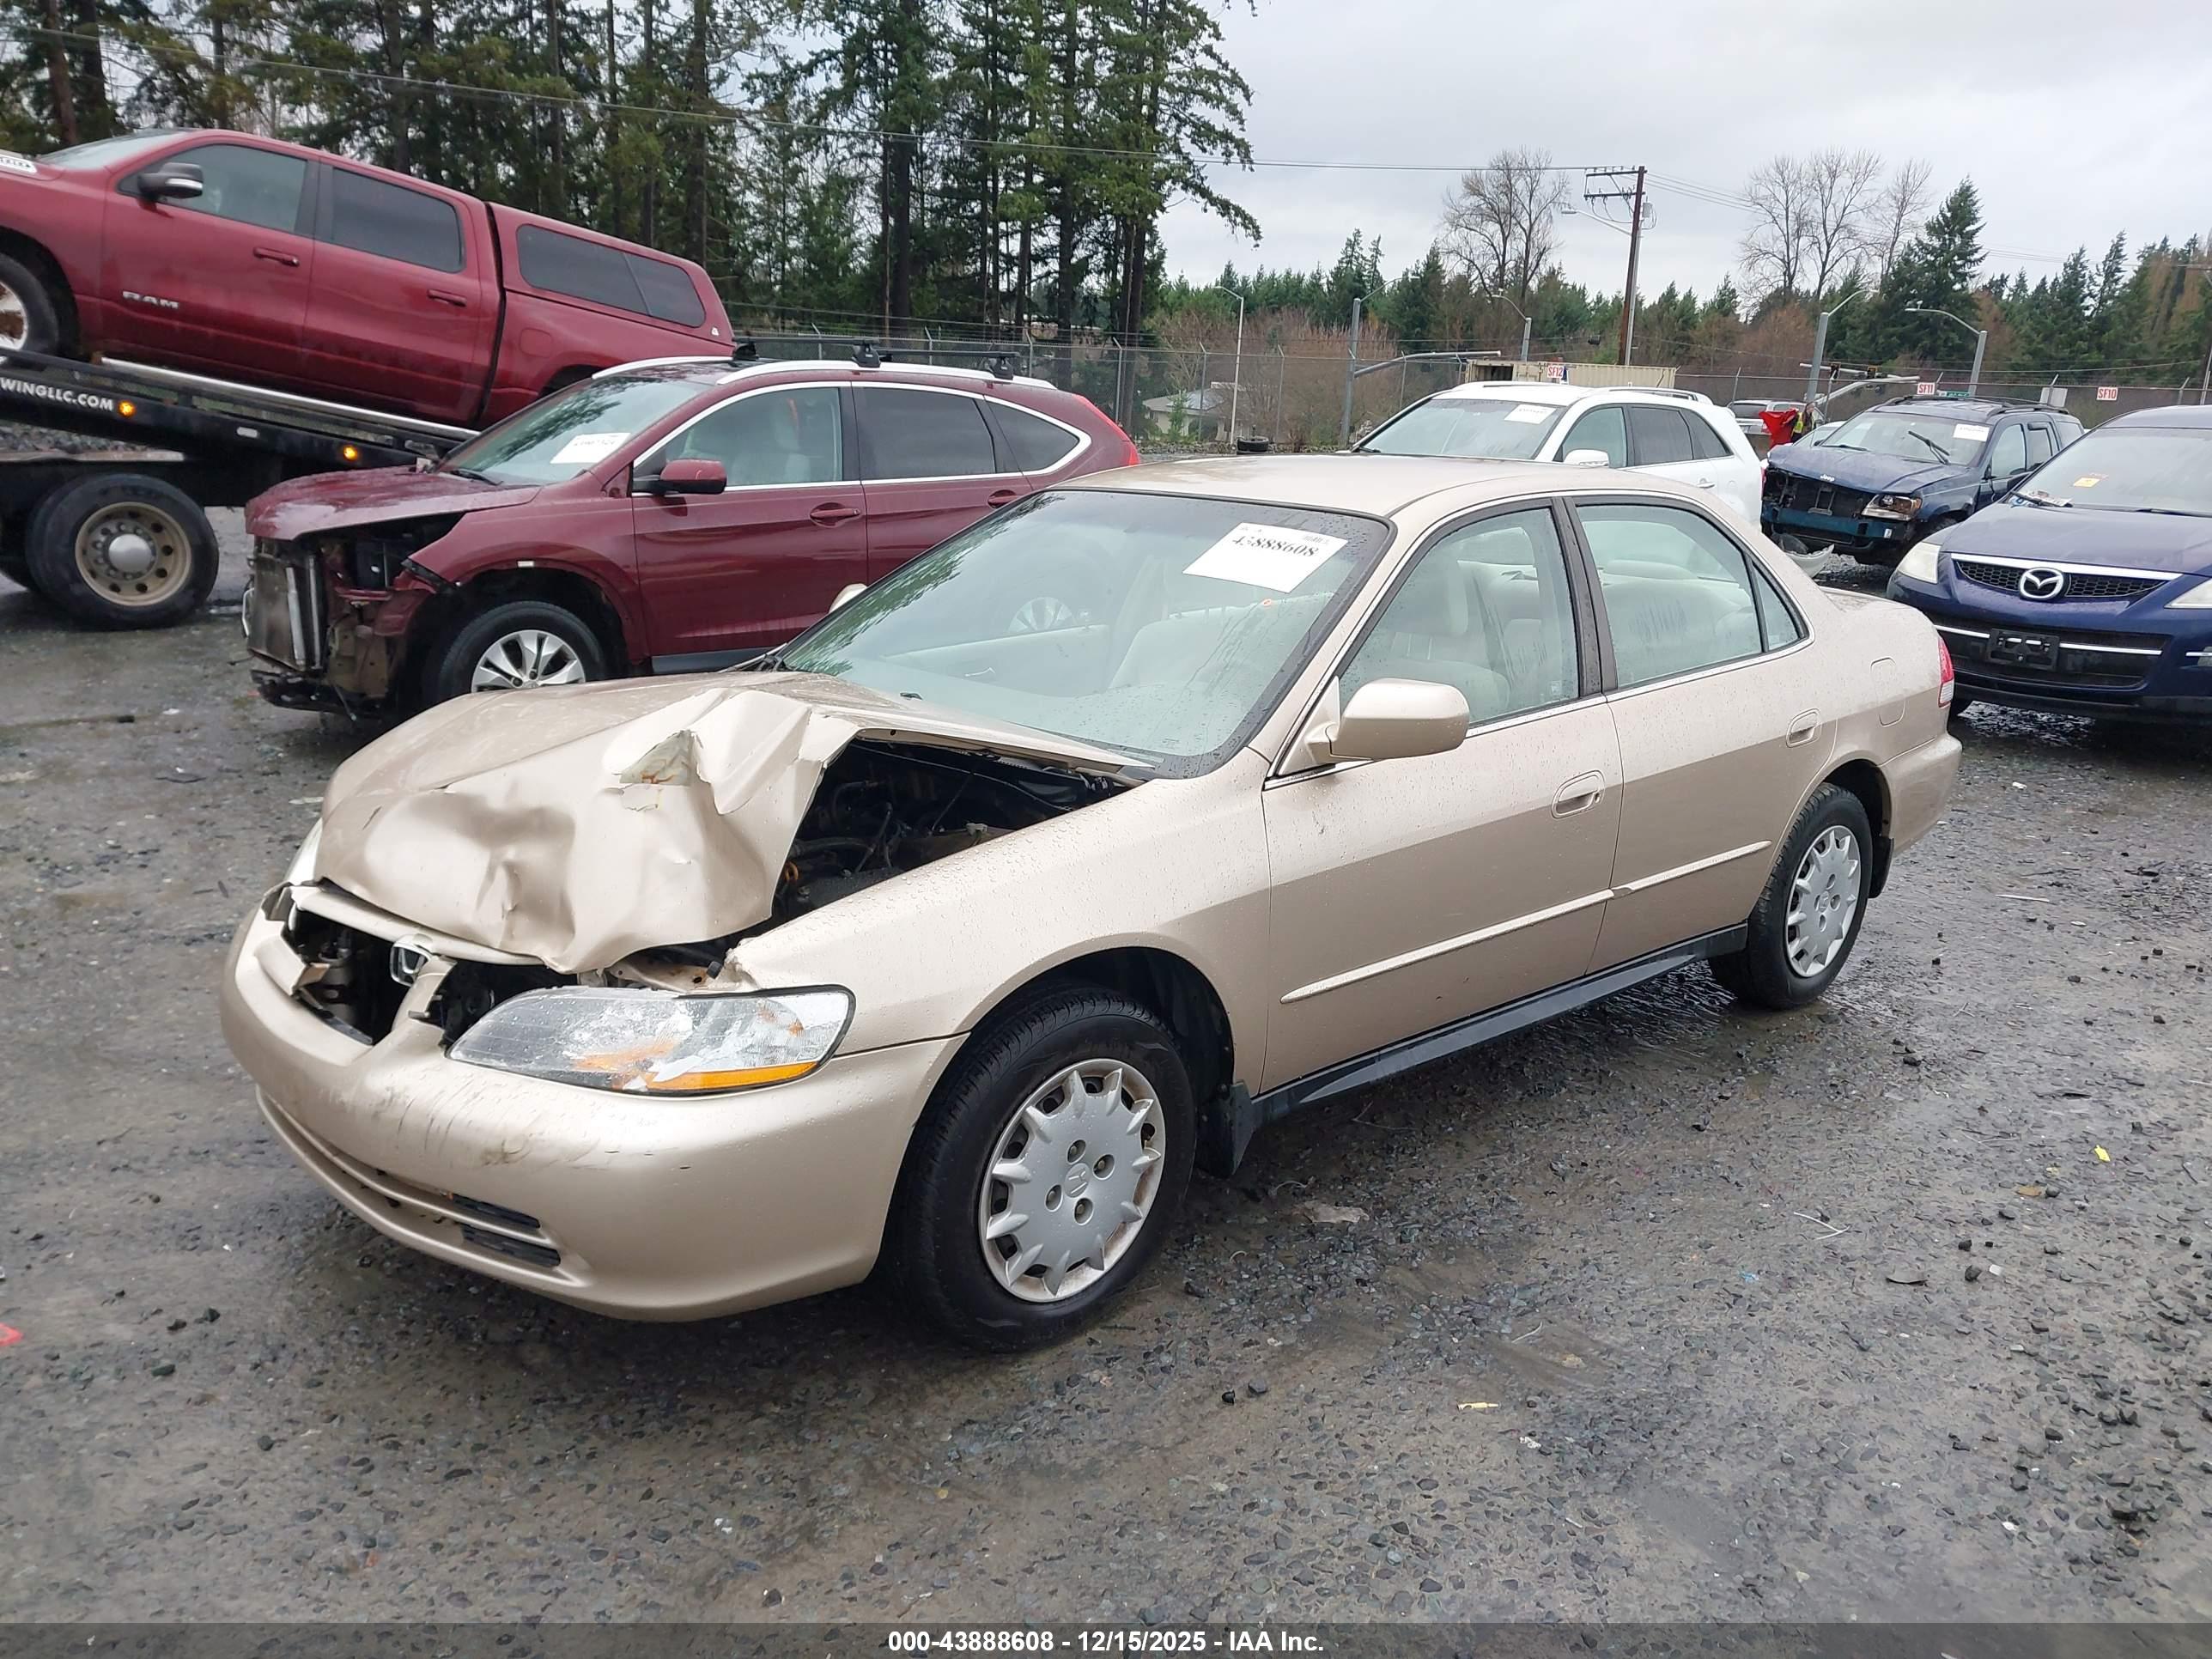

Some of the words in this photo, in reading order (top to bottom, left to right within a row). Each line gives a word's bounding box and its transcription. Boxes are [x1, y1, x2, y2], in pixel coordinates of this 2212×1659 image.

[122, 290, 179, 309] RAM
[1547, 366, 1564, 377] SF12
[0, 377, 113, 411] WINGLLC.COM
[1918, 384, 1934, 393] SF11
[2098, 388, 2117, 399] SF10
